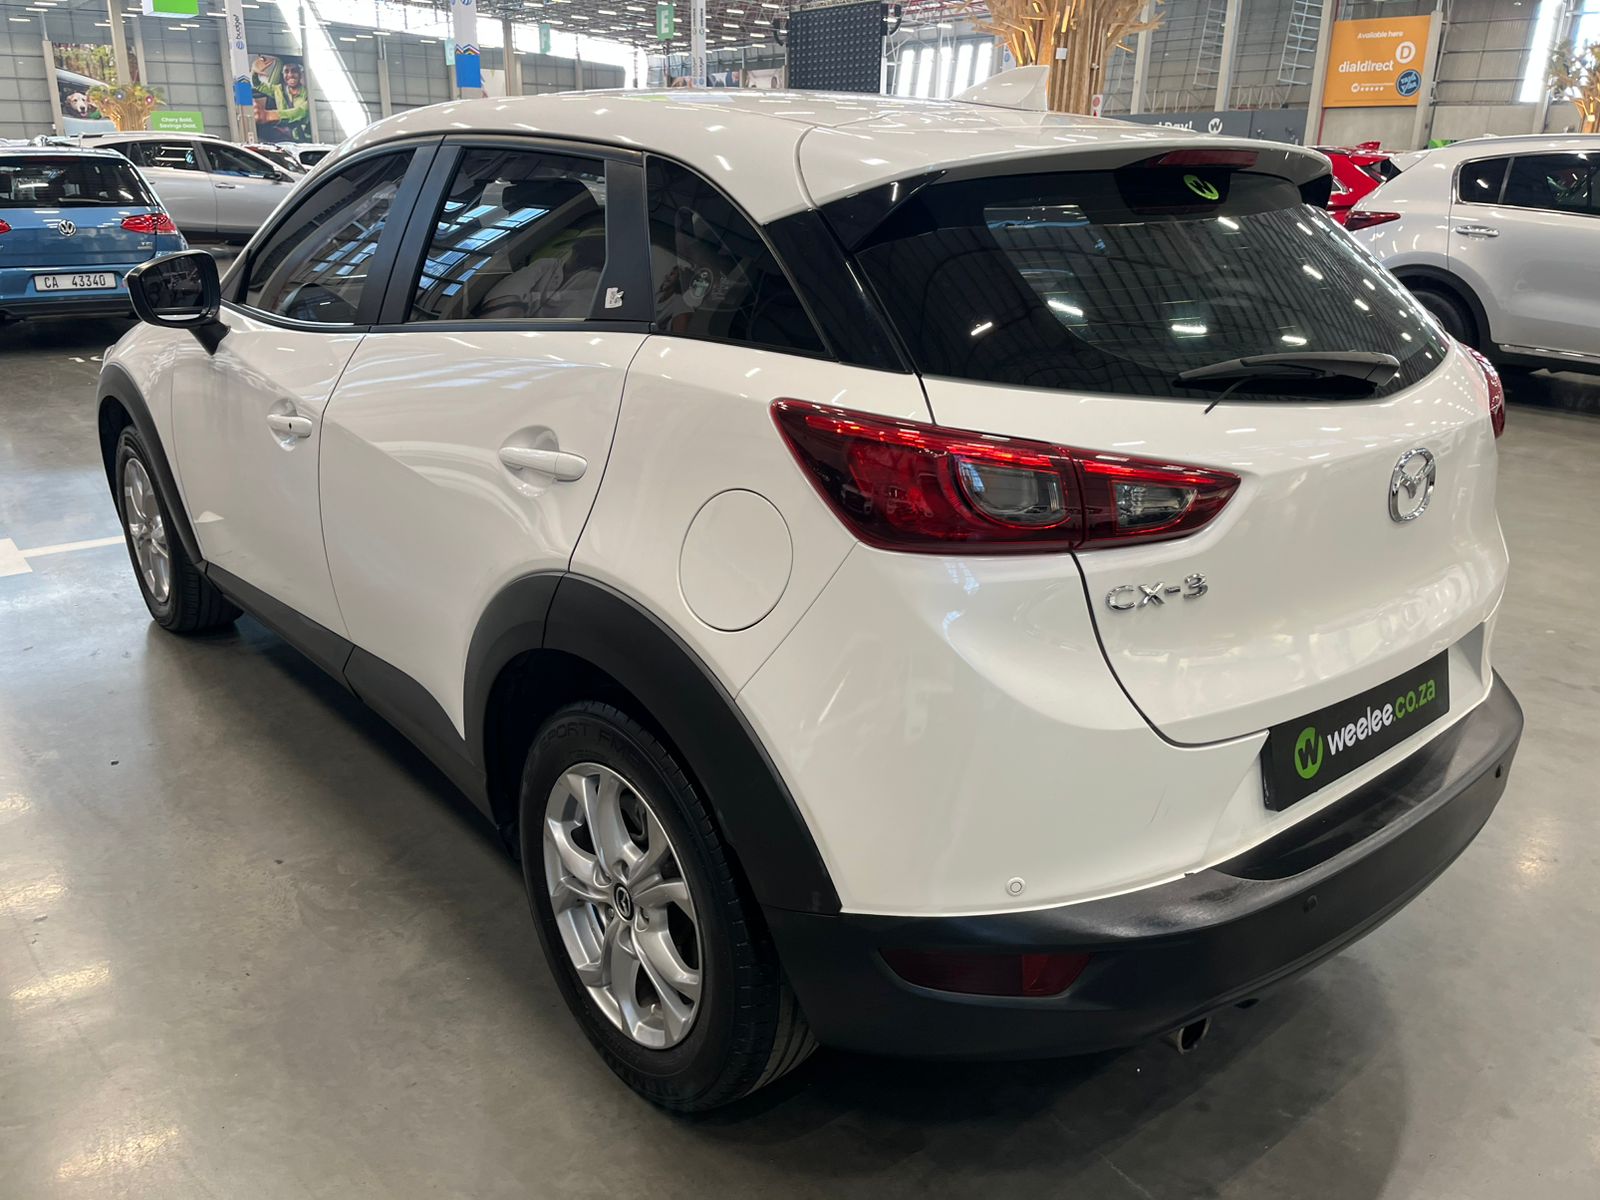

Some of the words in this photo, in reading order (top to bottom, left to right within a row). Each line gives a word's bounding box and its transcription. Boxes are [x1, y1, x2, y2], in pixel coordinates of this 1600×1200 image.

[661, 10, 670, 34] E
[1357, 32, 1387, 40] Available
[1338, 60, 1394, 73] dialdirect
[44, 276, 59, 289] CA
[71, 274, 106, 288] 43340
[1105, 573, 1209, 611] CX-3
[1327, 679, 1436, 756] weelee.co.za
